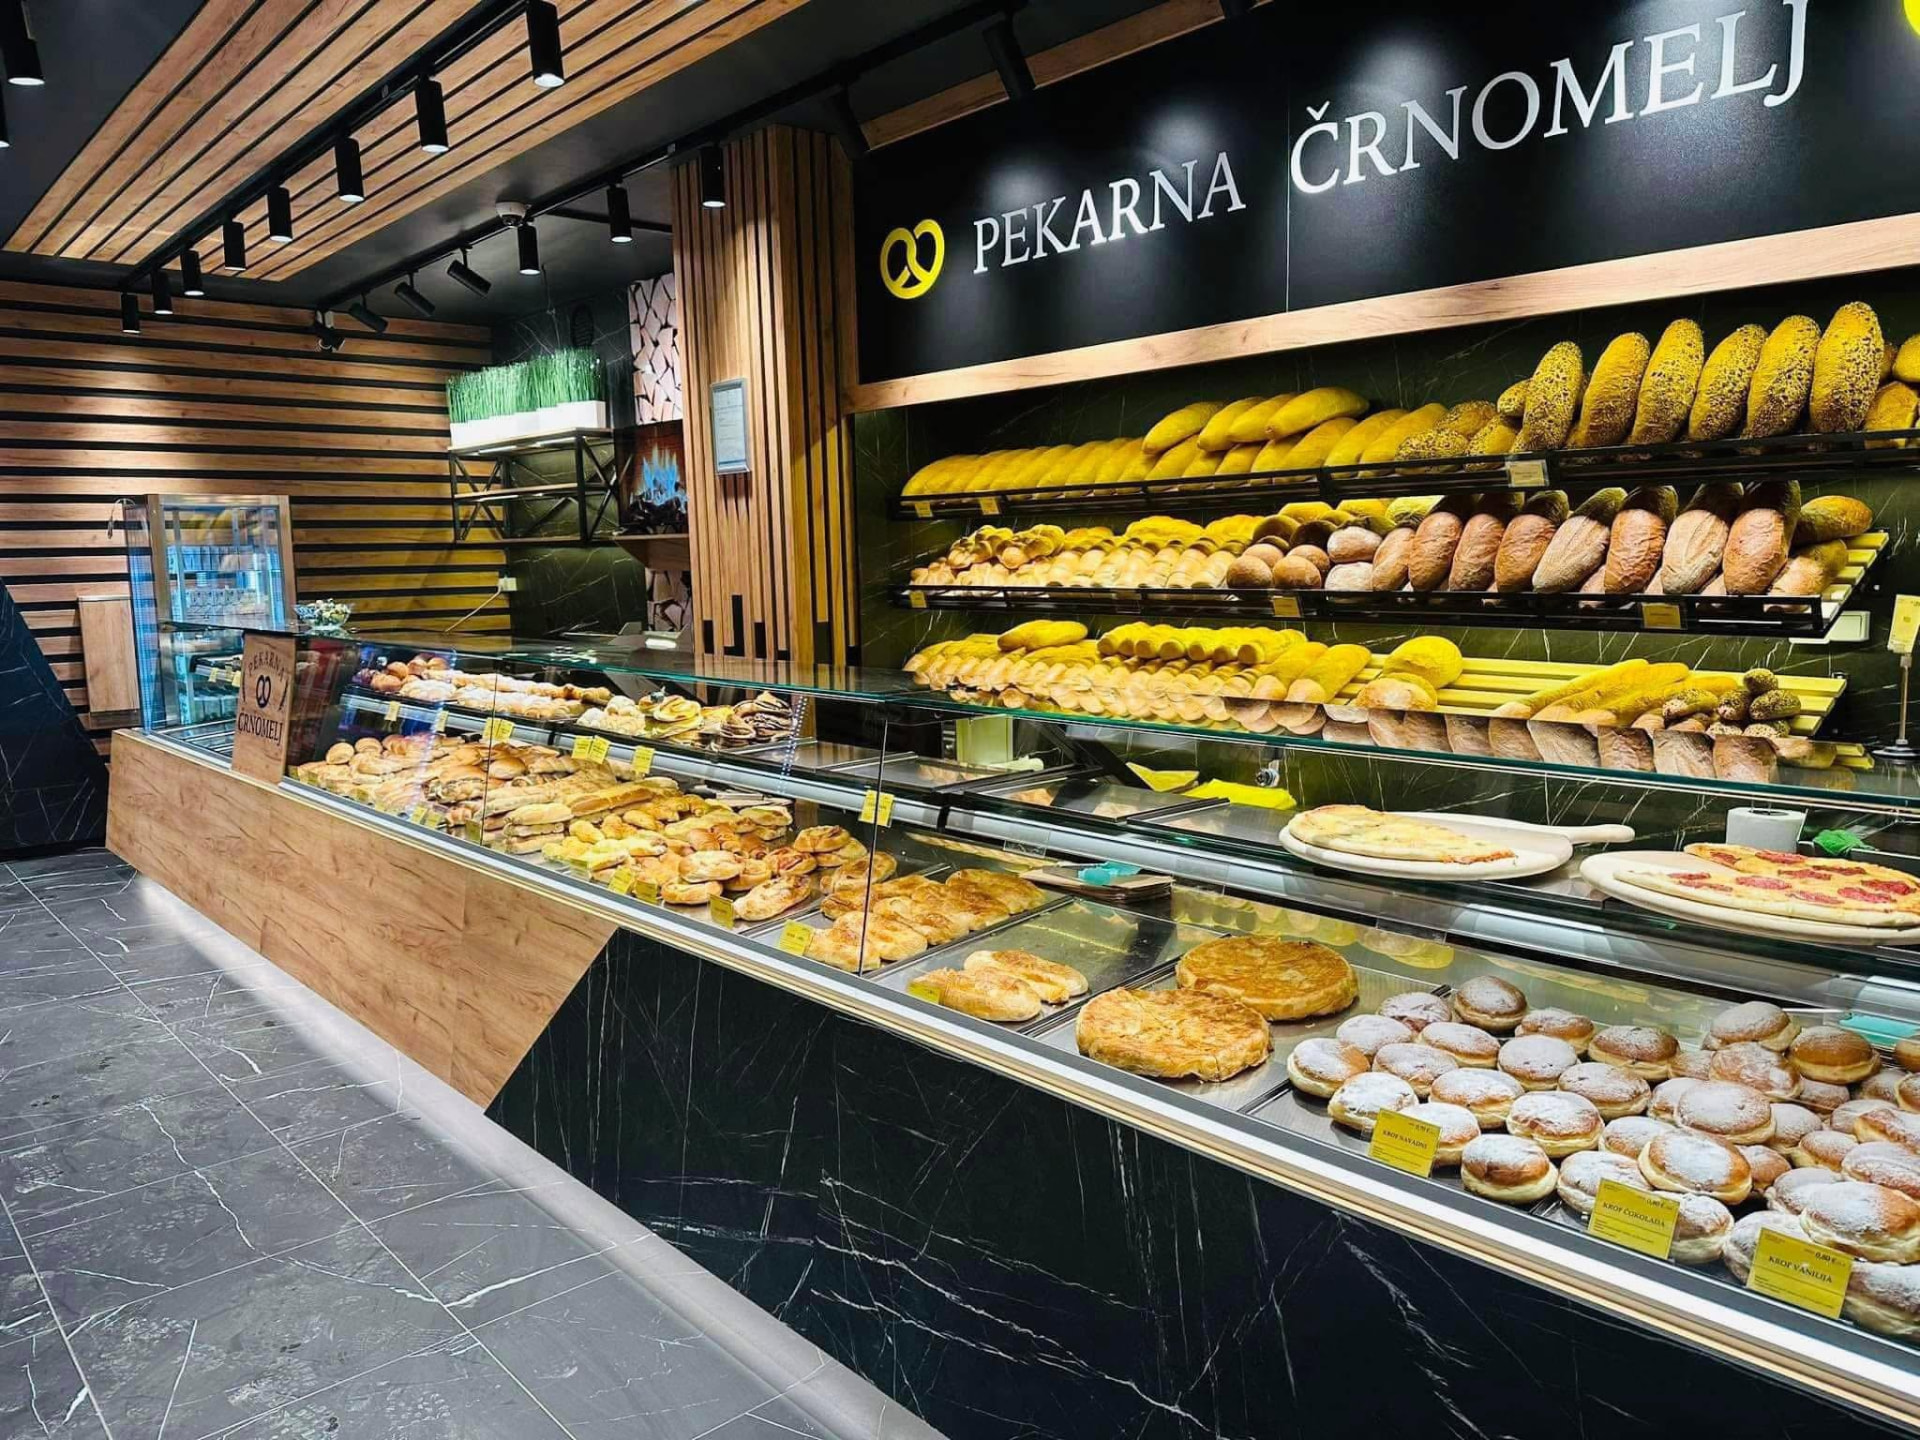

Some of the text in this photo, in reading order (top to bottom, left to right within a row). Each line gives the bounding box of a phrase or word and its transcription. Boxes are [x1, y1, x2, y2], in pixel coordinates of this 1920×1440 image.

[972, 0, 1808, 275] PEKARNA ČRNOMELJ
[247, 651, 286, 682] PEKARNA
[1382, 1129, 1428, 1150] KROF NAVADNI
[1603, 1202, 1665, 1228] KROF ČOKOLADA
[1769, 1255, 1792, 1268] KROF
[1793, 1264, 1833, 1284] VANILIJA
